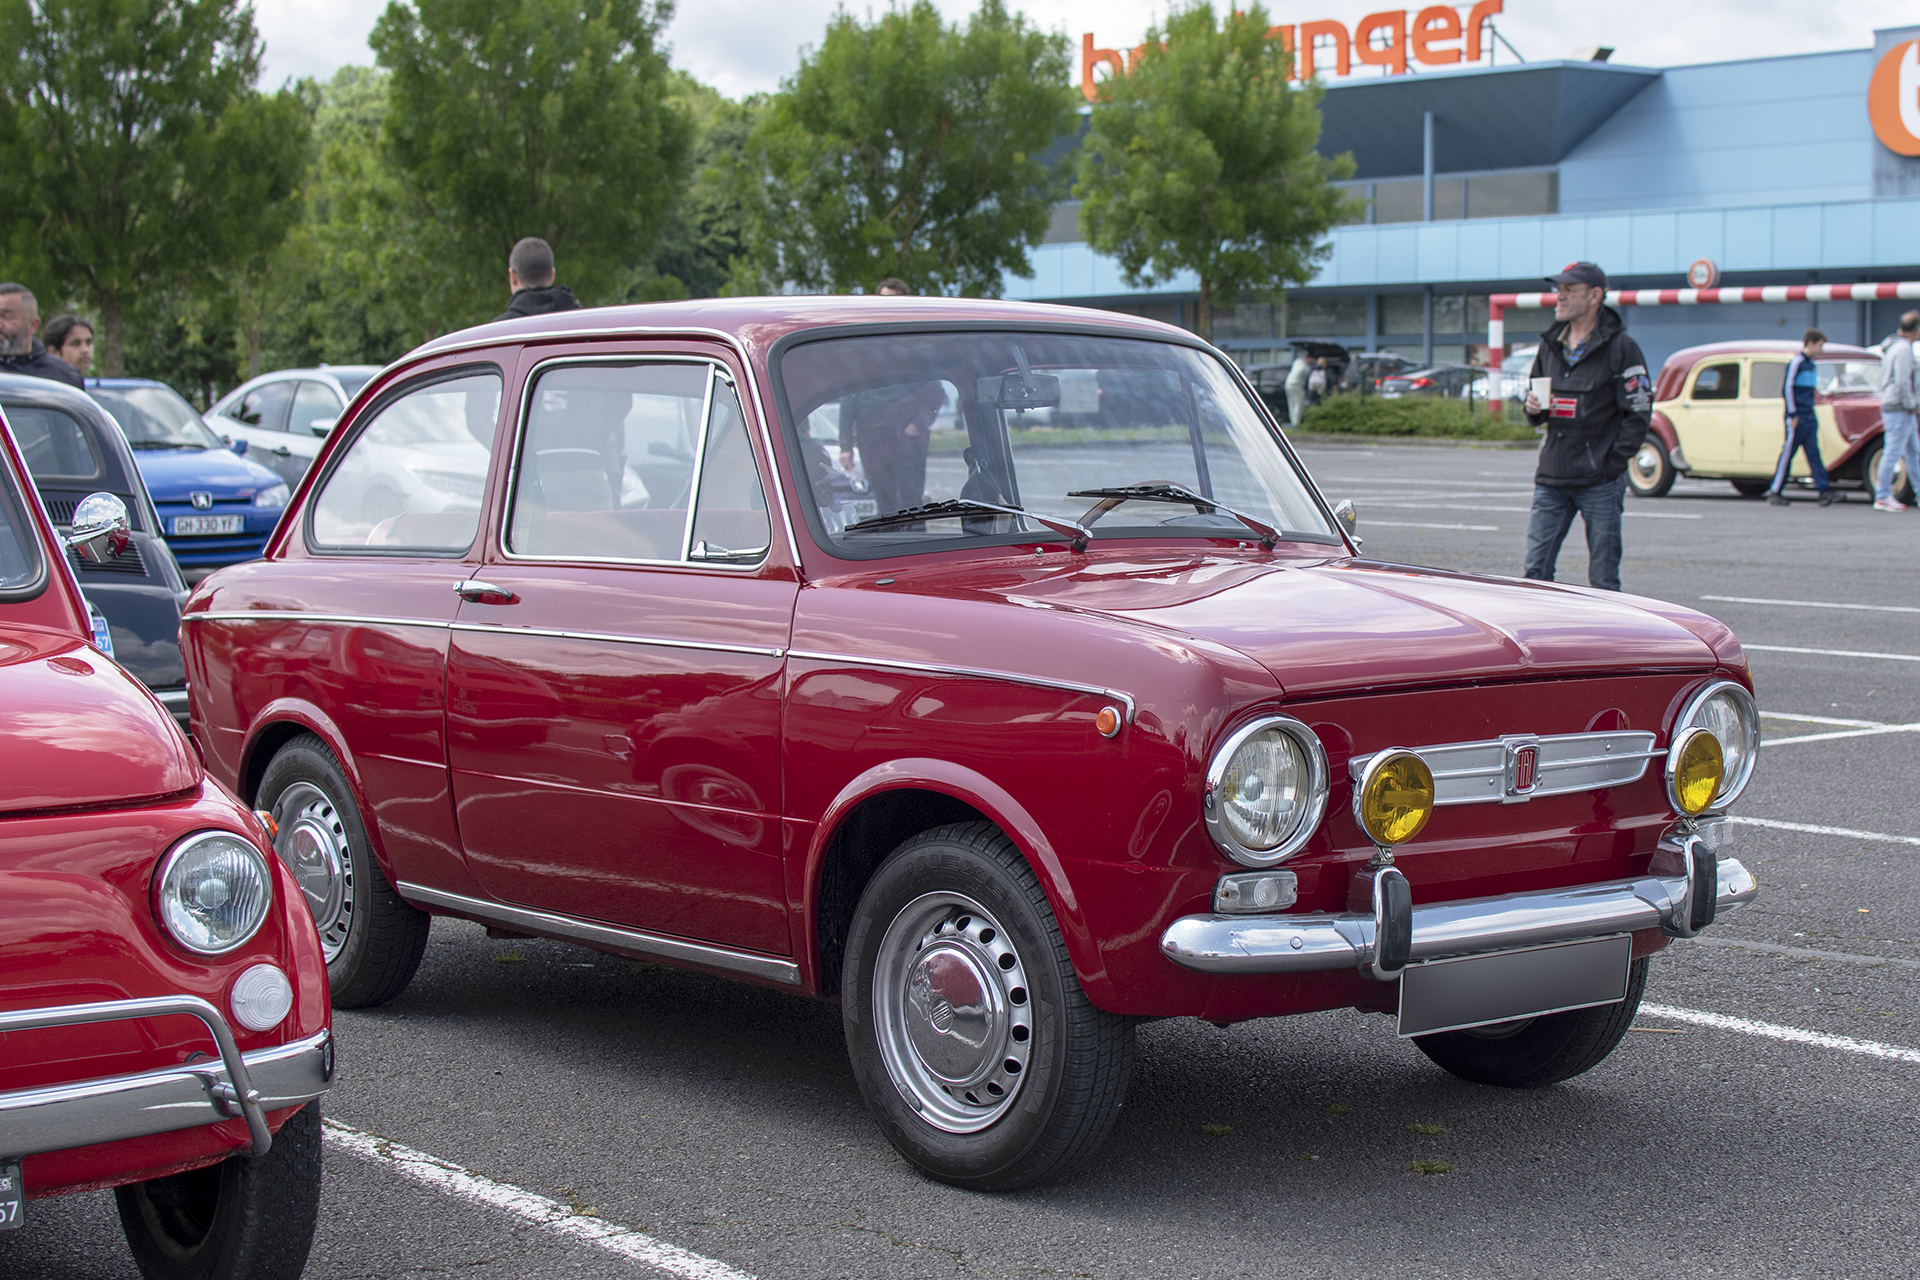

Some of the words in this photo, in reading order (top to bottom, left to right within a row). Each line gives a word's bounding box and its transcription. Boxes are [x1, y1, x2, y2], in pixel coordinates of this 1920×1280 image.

[1082, 0, 1502, 103] bnger
[1516, 750, 1535, 787] FIAT
[917, 854, 1028, 928] NEXEN
